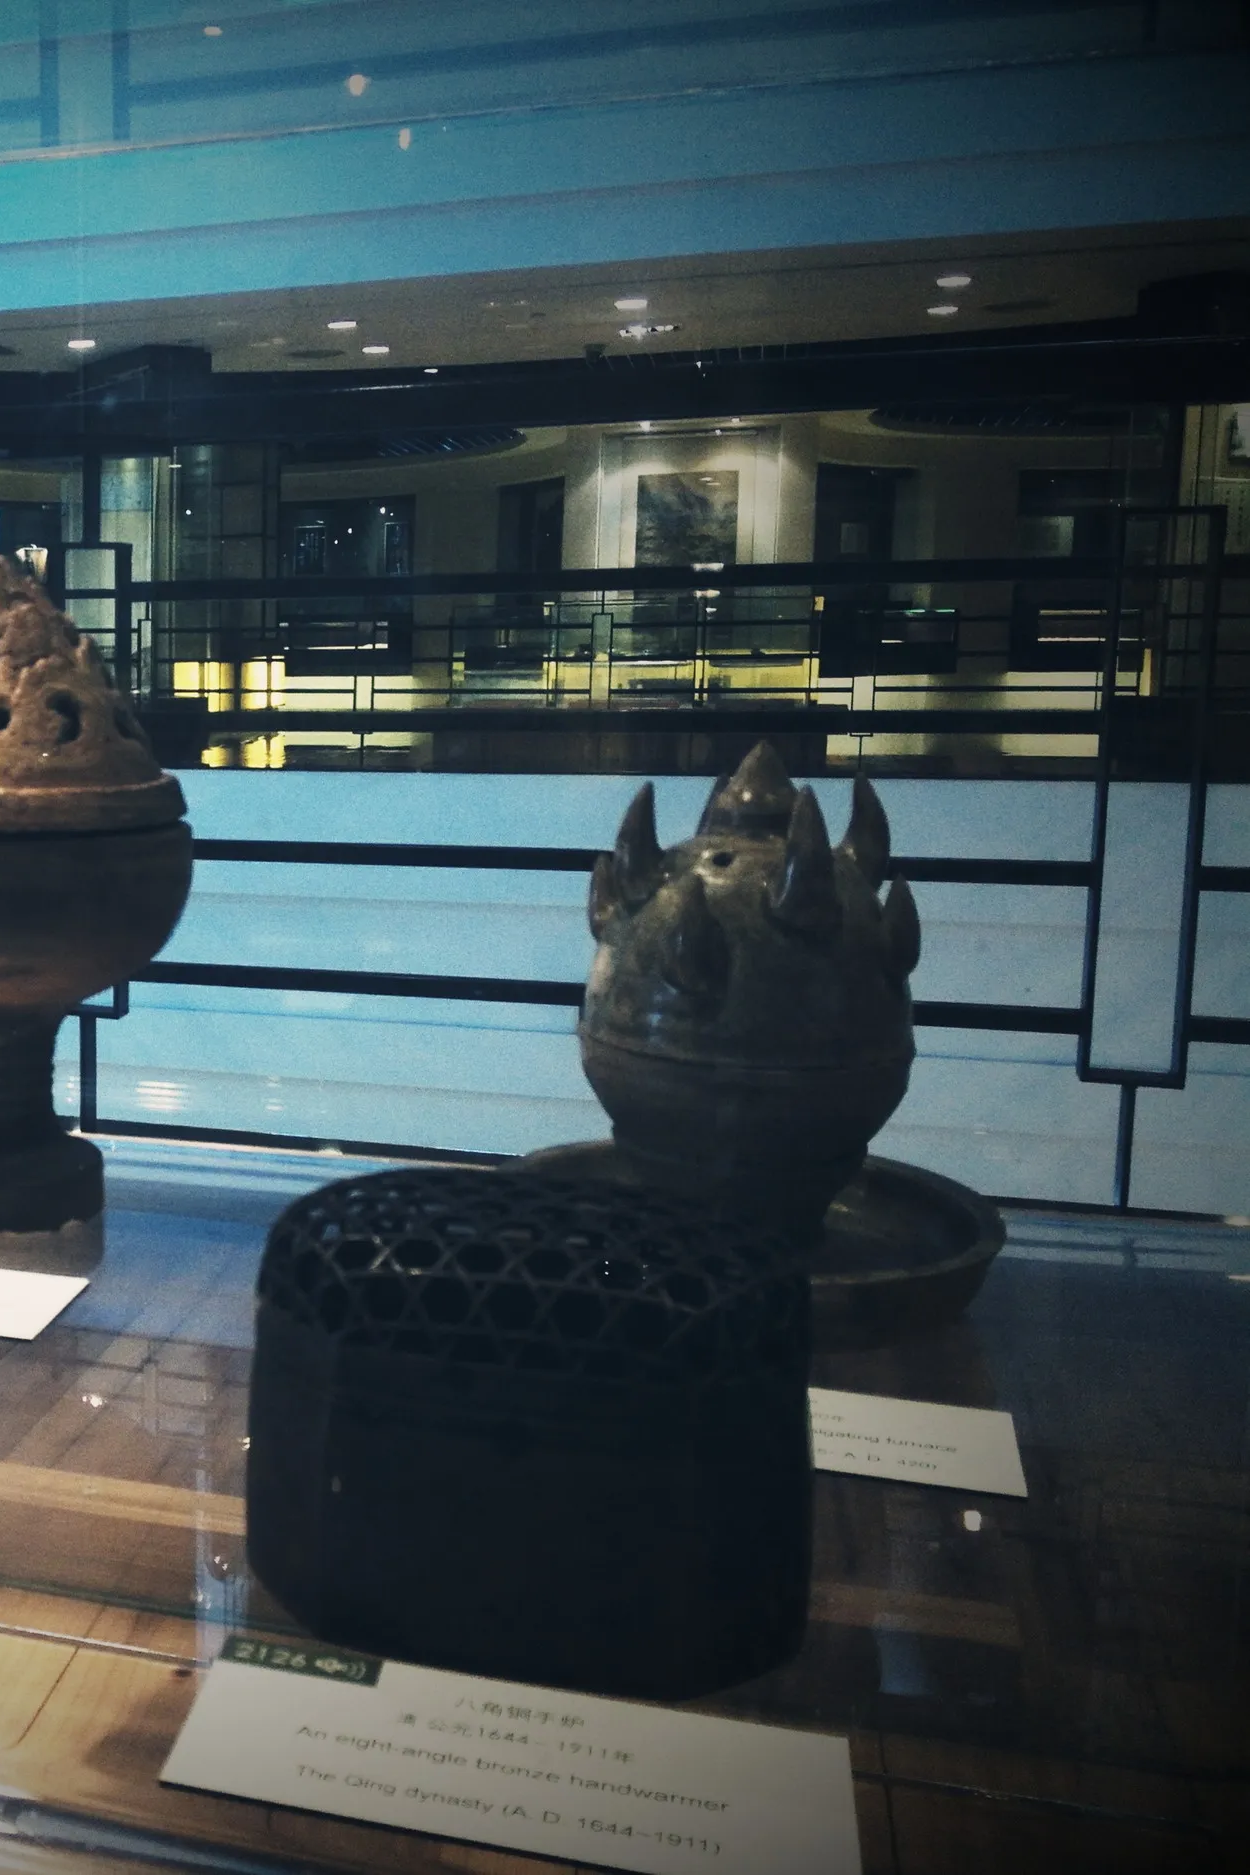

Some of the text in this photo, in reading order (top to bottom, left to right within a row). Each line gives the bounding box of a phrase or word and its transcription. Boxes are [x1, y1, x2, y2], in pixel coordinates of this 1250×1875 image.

[234, 1641, 307, 1668] 2126
[296, 1725, 730, 1813] An eight-angle bronze handwarmer
[297, 1763, 337, 1782] The
[344, 1773, 398, 1798] Qing
[405, 1785, 495, 1815] dynasty
